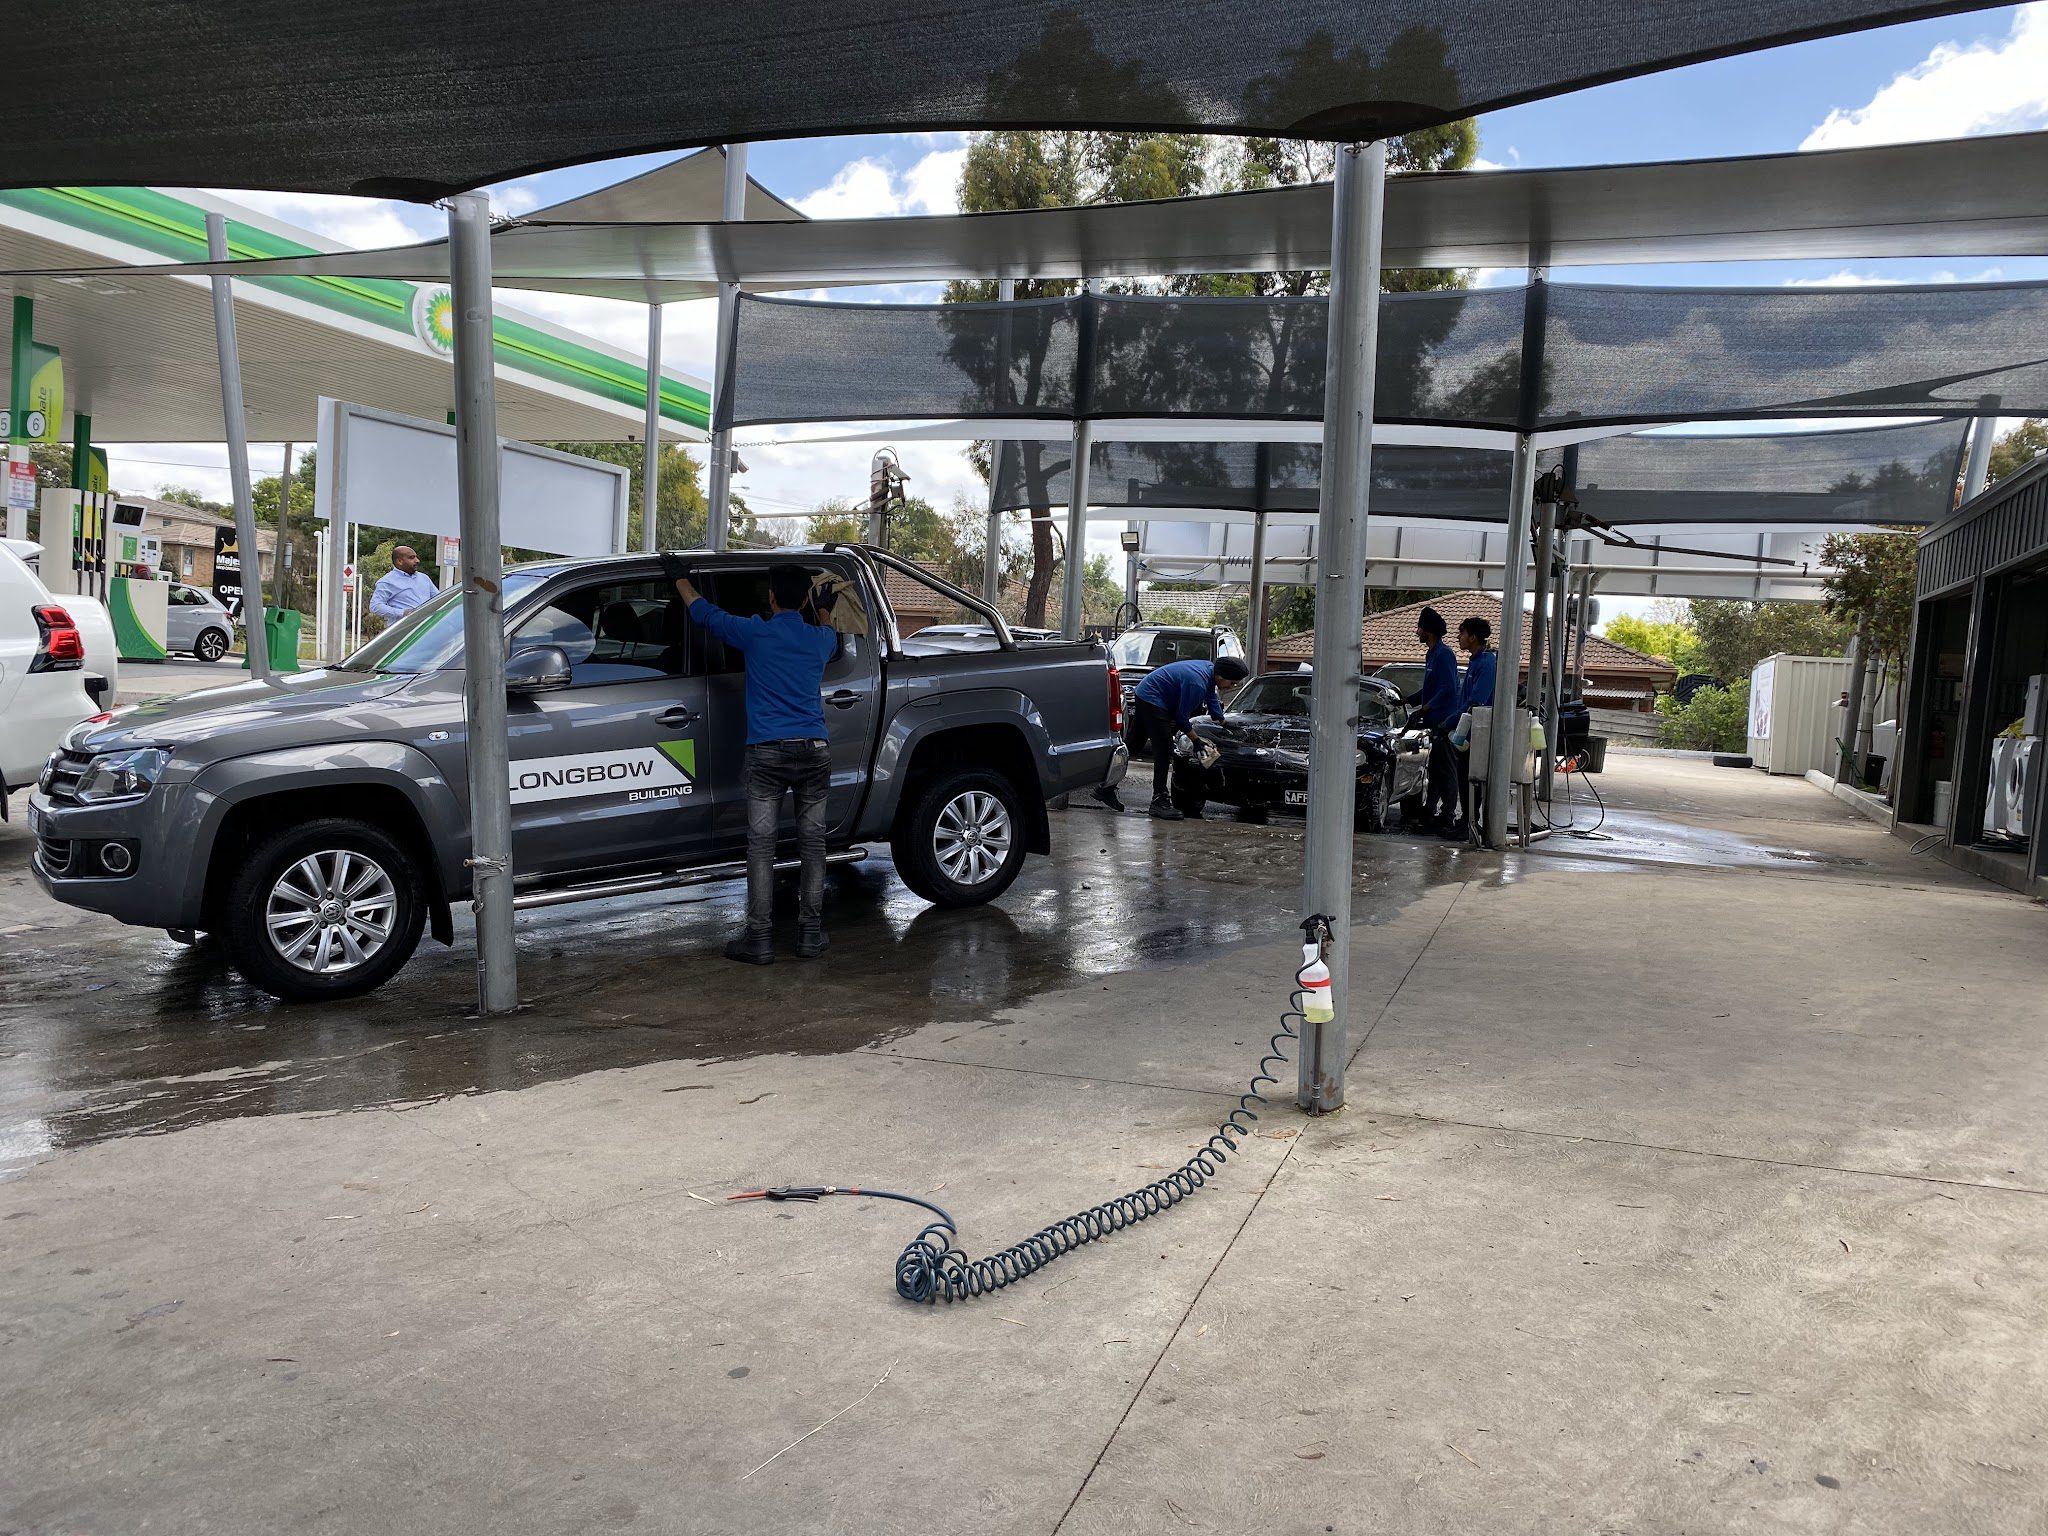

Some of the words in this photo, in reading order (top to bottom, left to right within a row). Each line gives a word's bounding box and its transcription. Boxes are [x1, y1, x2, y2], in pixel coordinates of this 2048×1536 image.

[0, 417, 7, 431] 5
[32, 417, 40, 431] 6
[628, 785, 693, 802] BUILDING
